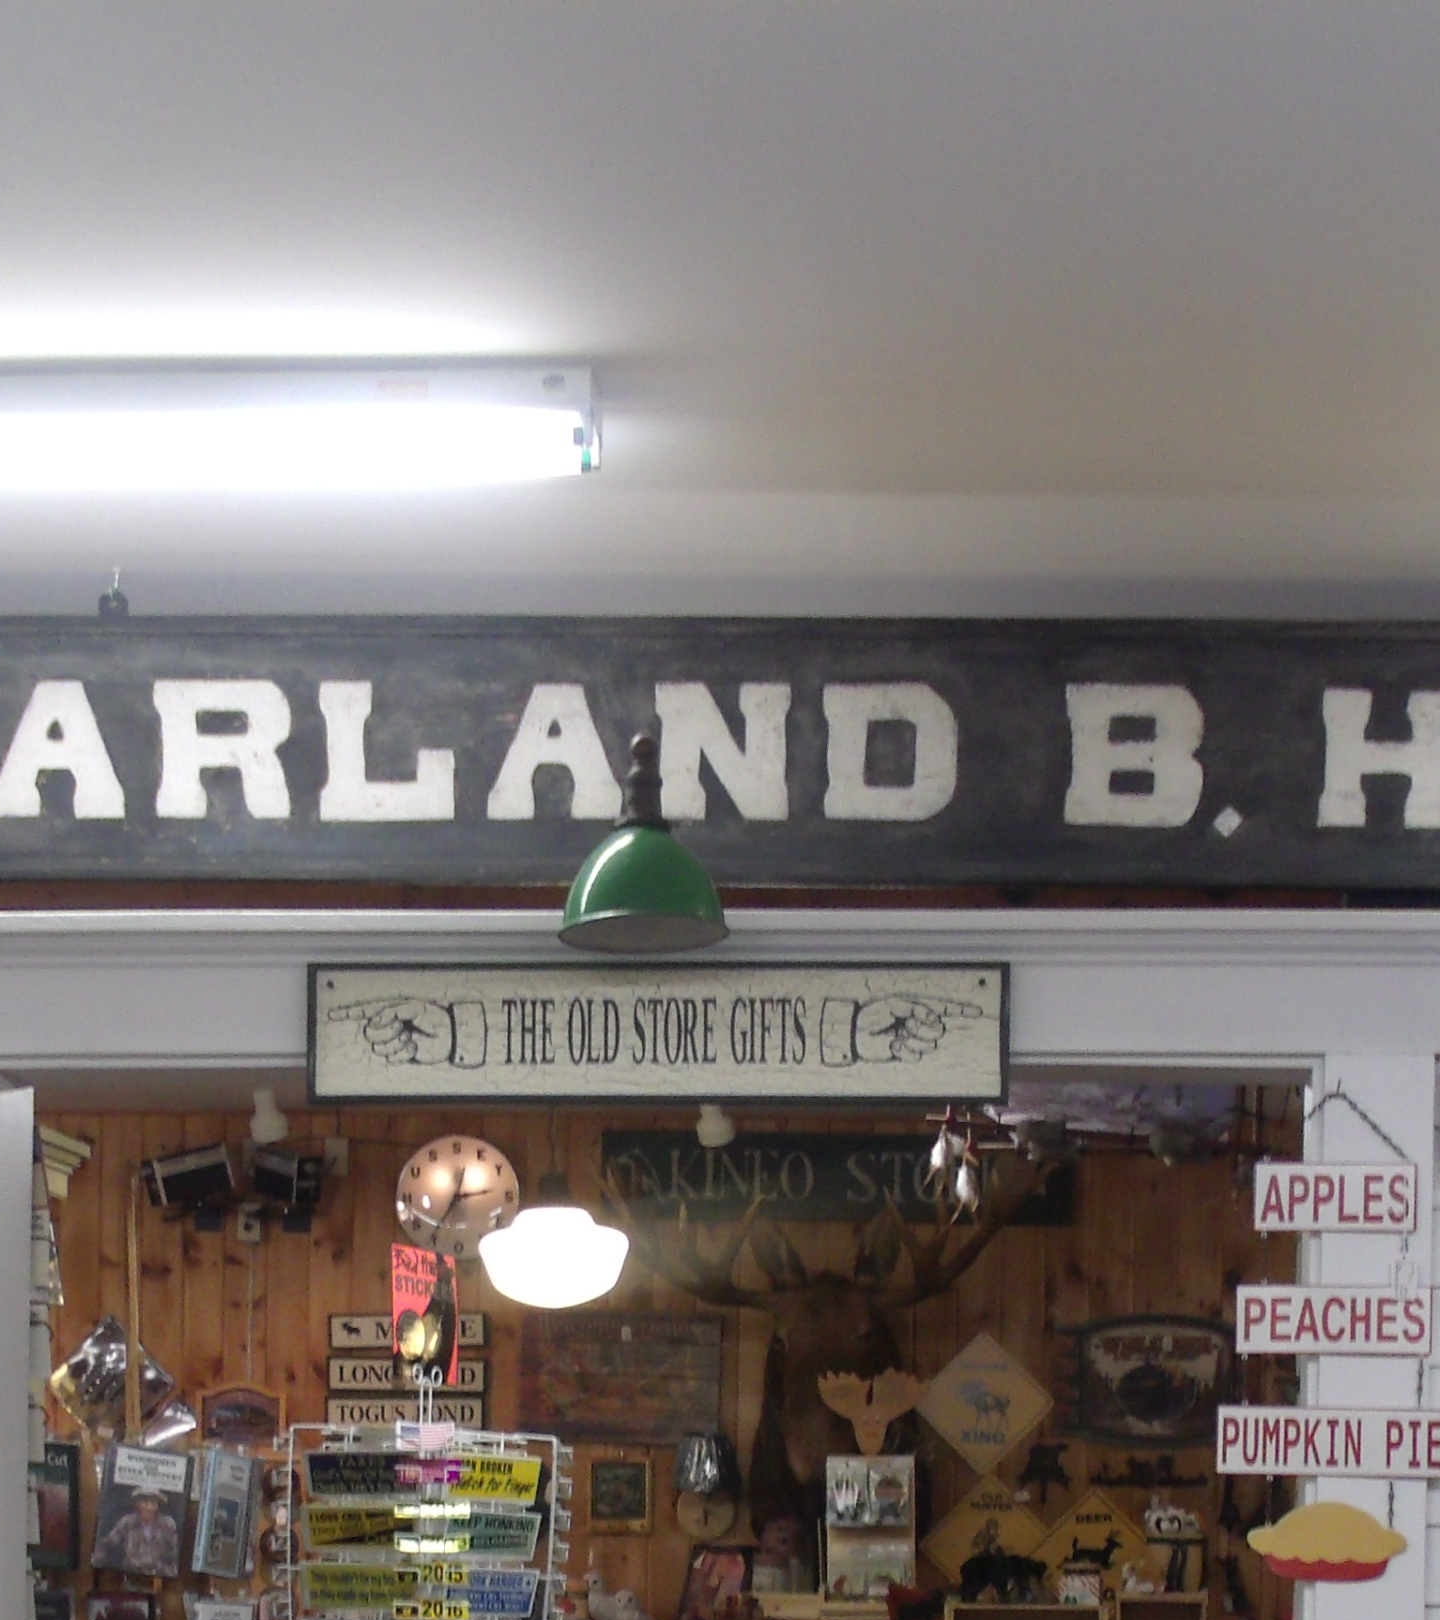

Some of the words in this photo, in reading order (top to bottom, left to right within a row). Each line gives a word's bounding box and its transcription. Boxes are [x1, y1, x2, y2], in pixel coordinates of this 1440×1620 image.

[1063, 682, 1244, 838] B.
[501, 997, 555, 1065] THE
[567, 997, 620, 1065] OLD
[632, 997, 718, 1065] STORE
[730, 997, 807, 1065] GIFTS
[846, 1149, 998, 1203] STO
[1260, 1175, 1409, 1223] APPLES
[1243, 1298, 1426, 1342] PEACHES
[336, 1406, 405, 1421] TOGUS
[416, 1406, 475, 1423] POND
[1222, 1417, 1361, 1467] PUMPKIN
[1076, 1515, 1112, 1523] DEER
